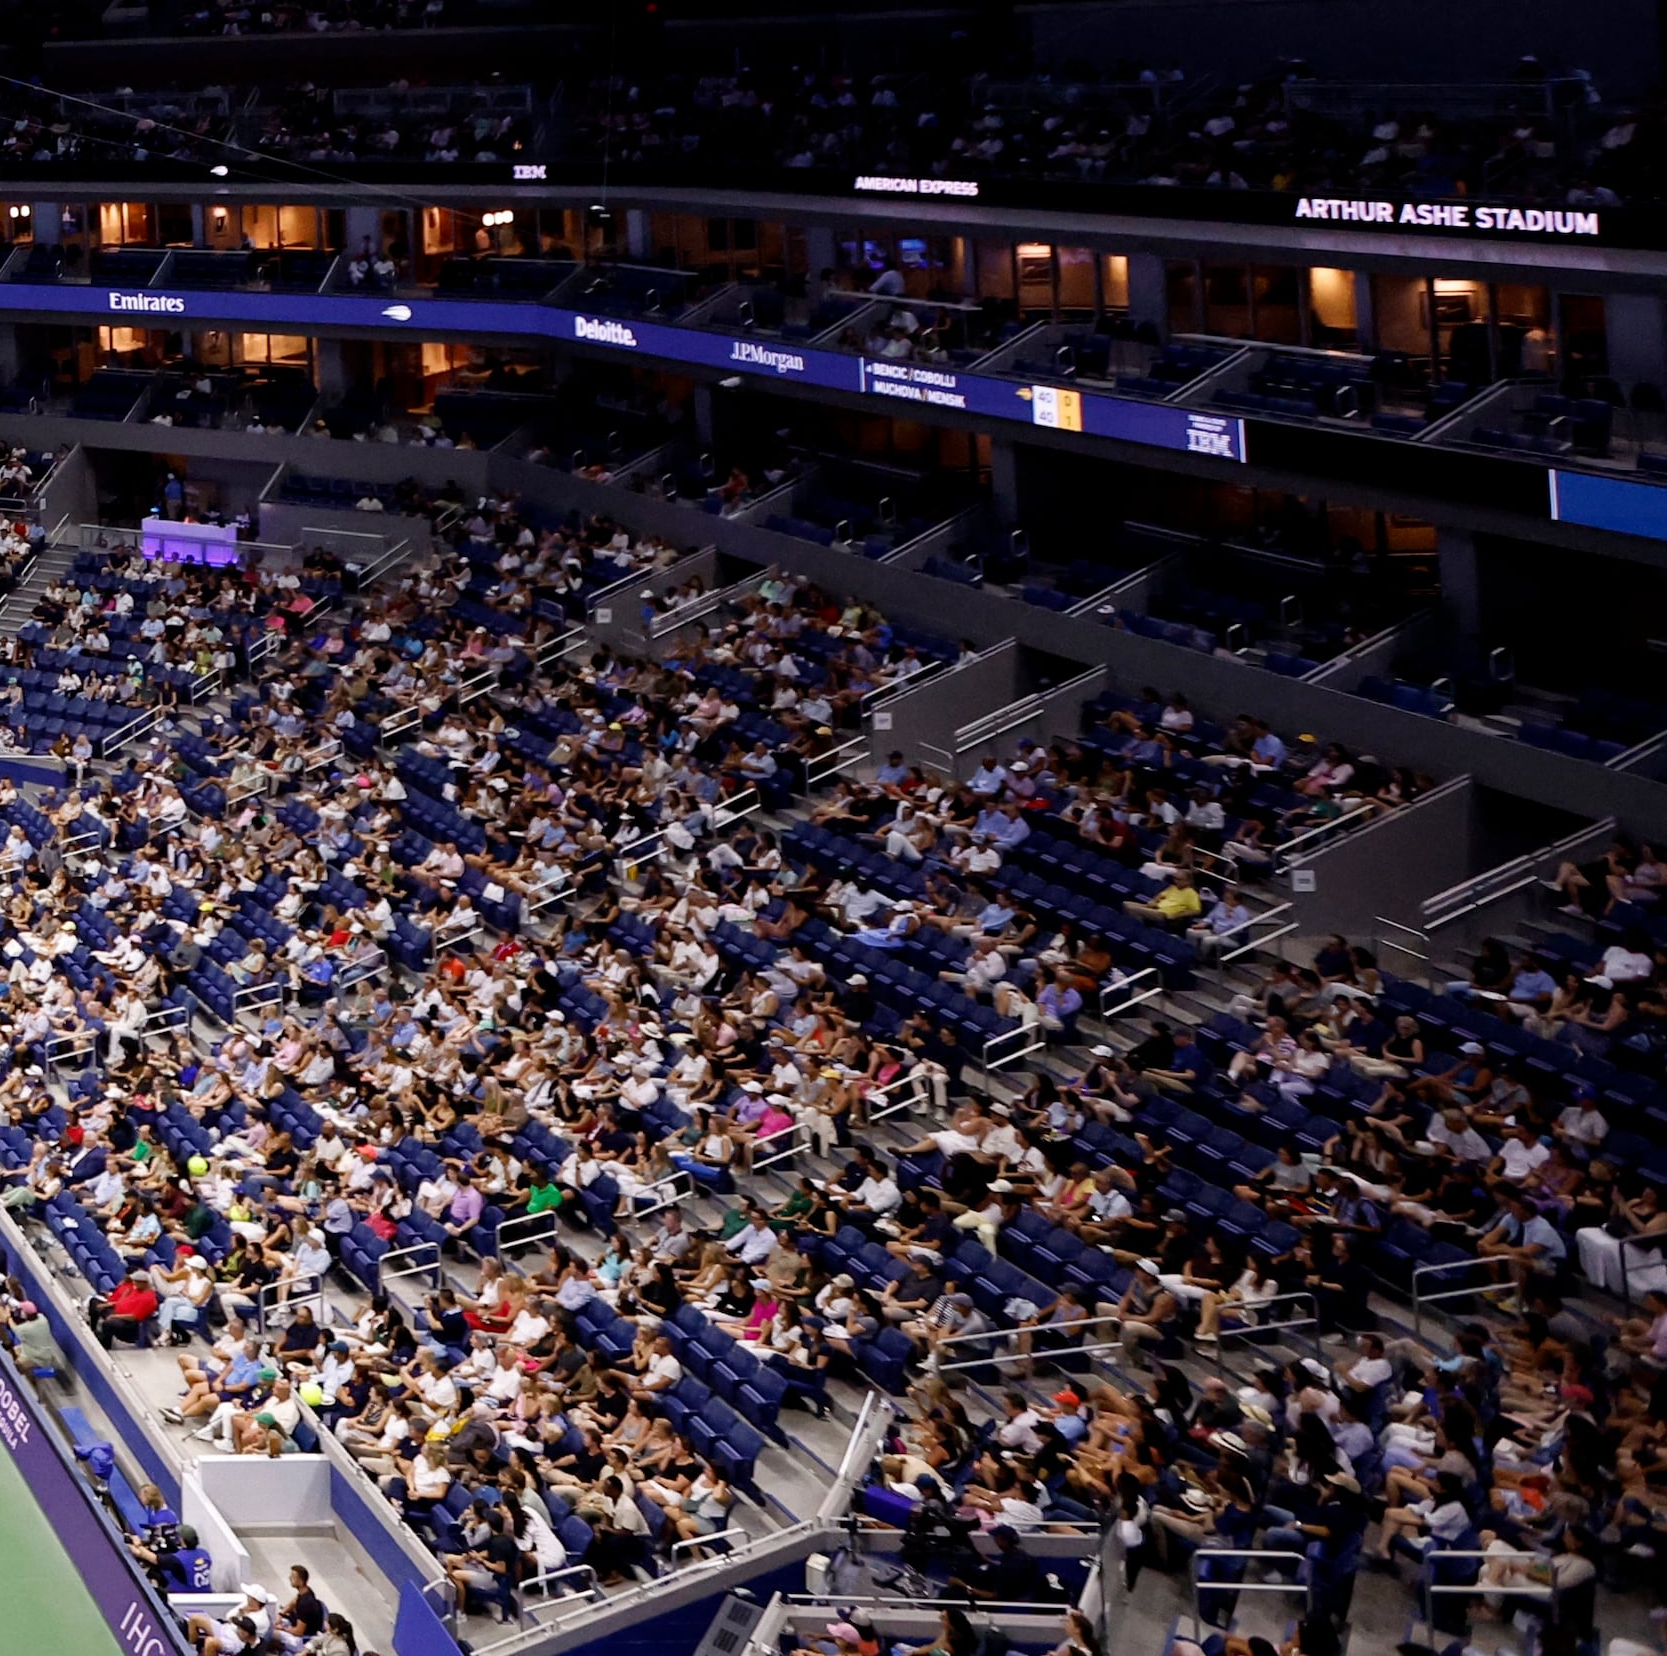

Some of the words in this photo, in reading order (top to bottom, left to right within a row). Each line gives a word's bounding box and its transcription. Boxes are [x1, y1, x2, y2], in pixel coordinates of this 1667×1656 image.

[514, 165, 546, 179] IBM
[855, 177, 916, 192] AMERICAN
[919, 180, 978, 196] EXPRESS
[1296, 198, 1393, 222] ARTHUR
[1399, 204, 1469, 226] ASHE
[1475, 207, 1598, 234] STADIUM
[110, 293, 184, 312] Emirates
[575, 316, 636, 346] Deloitte.
[731, 342, 804, 373] J.P.Morgan
[1186, 429, 1235, 457] IBM
